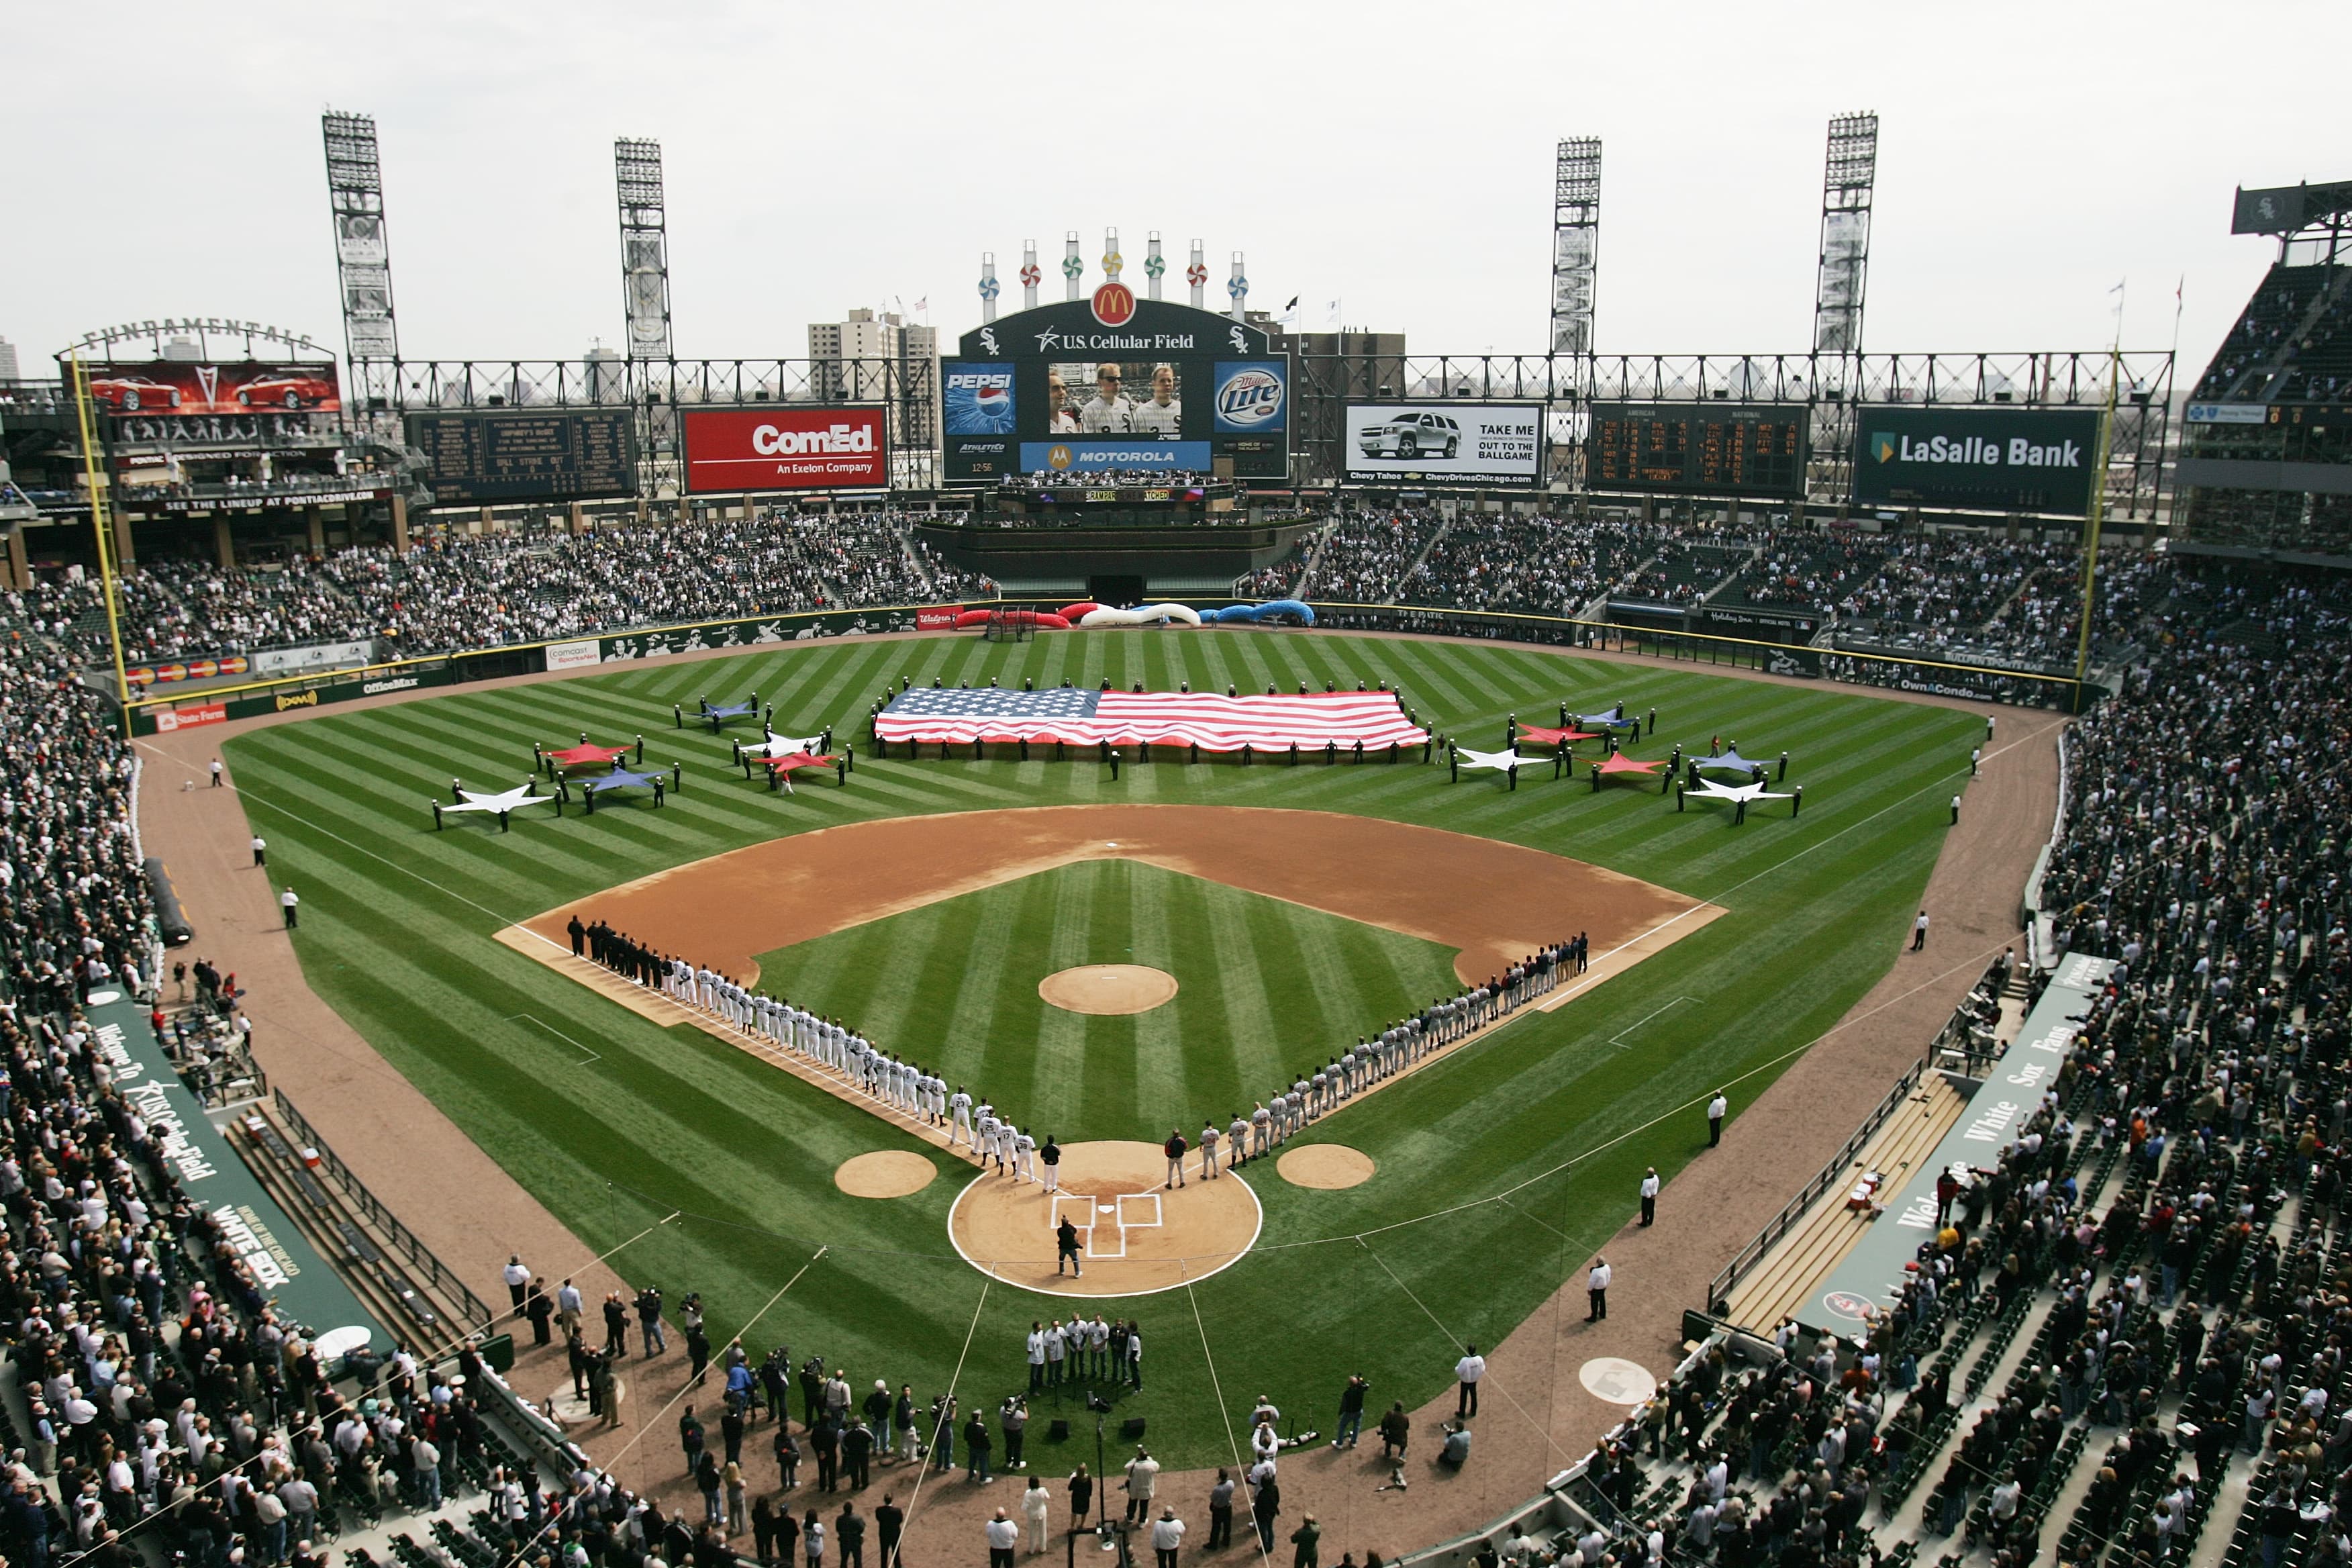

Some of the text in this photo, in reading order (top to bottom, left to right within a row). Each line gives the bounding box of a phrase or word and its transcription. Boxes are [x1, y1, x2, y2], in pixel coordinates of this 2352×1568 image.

[82, 317, 313, 350] FUNDAMENTALS
[1063, 334, 1194, 349] U.S. Cellular Field
[948, 374, 1012, 389] PEPSI
[1236, 377, 1269, 387] Miller
[1223, 383, 1280, 415] Lite
[1480, 425, 1534, 435] TAKE ME
[752, 424, 873, 455] ComEd
[1479, 442, 1533, 451] OUT TO THE
[1079, 452, 1175, 462] MOTOROLA
[1479, 451, 1533, 460] BALLGAME
[1900, 435, 2080, 467] LaSalle Bank
[777, 462, 873, 474] An Exelon Company
[1350, 472, 1532, 484] Chevy Tahoe ChevyDrivesChicago.com
[165, 490, 375, 511] SEE THE LINEUP AT PONTIACDRIVE.COM
[1711, 611, 1738, 624] Holiday
[1738, 615, 1753, 624] Inn
[1945, 651, 1985, 665] BULLPEN
[363, 677, 418, 694] OfficeMax
[1901, 679, 1993, 701] OwnACondo.com
[177, 710, 225, 726] State Farm
[96, 1022, 145, 1080] Welcome To
[1963, 1100, 2018, 1142] White
[2006, 1061, 2046, 1089] Sox
[2030, 1024, 2074, 1054] Fans
[171, 1145, 217, 1182] Field
[212, 1204, 290, 1290] WHITE SOX
[236, 1204, 302, 1277] HOME OF THE CHICAGO
